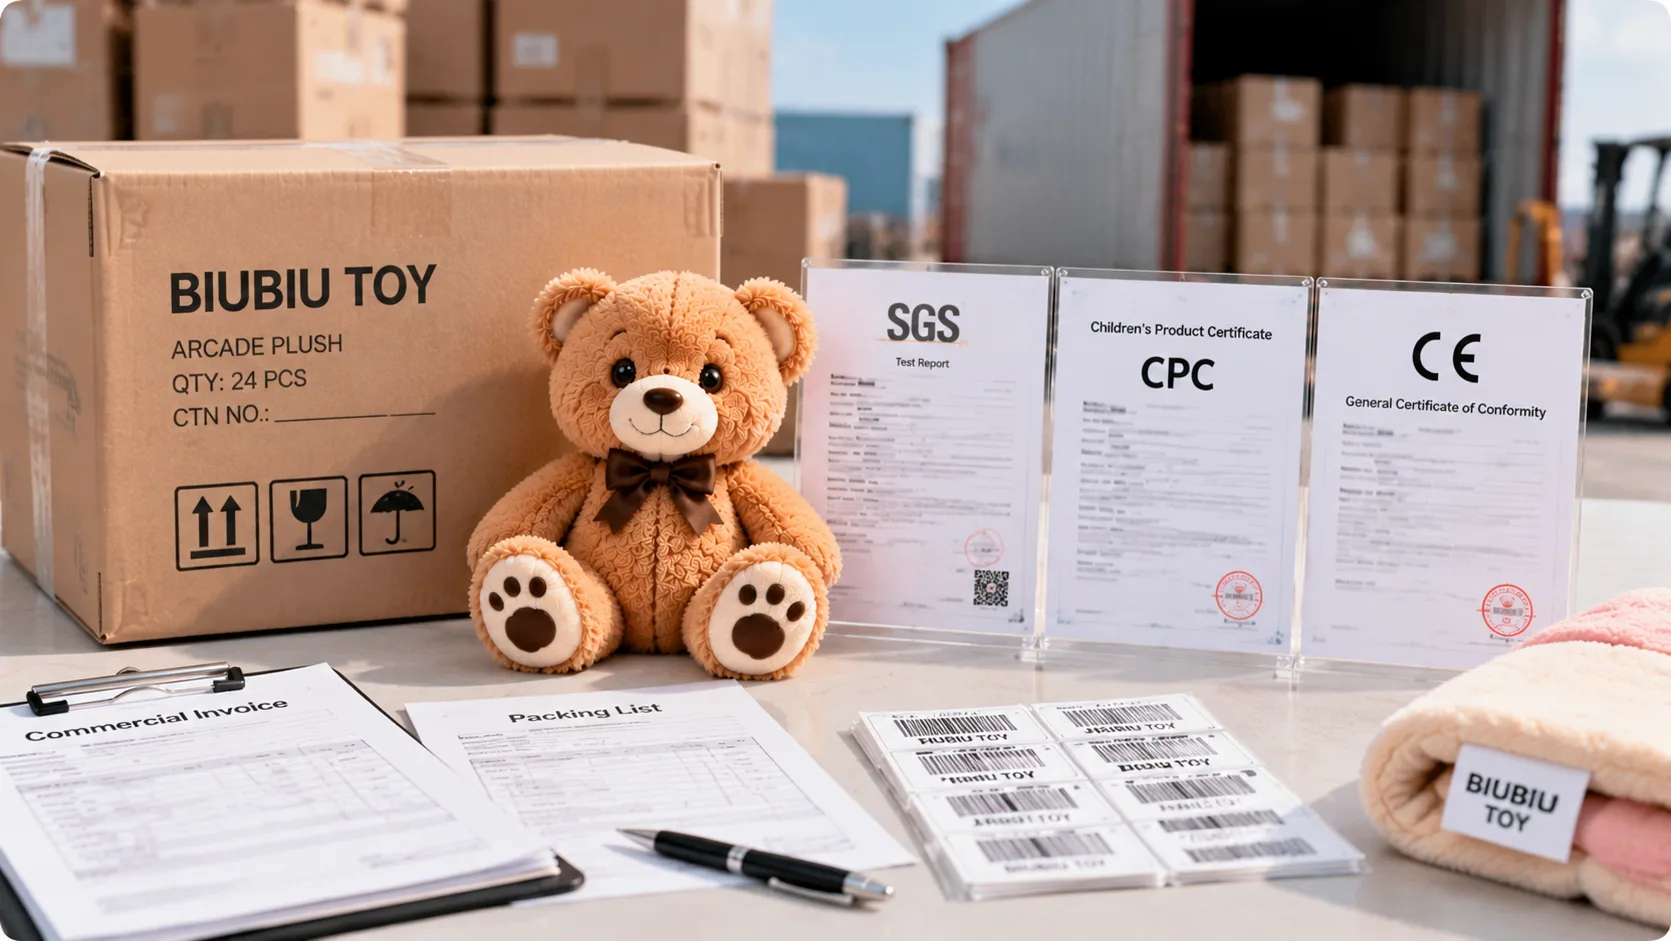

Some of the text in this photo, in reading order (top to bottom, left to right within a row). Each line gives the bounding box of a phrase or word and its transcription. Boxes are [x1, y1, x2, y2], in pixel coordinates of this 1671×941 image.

[170, 264, 437, 314] BIUBIU TOY
[887, 302, 960, 343] SGS
[1090, 320, 1273, 340] Children's Product Certificate
[171, 334, 343, 360] ARCADE PLUSH
[1412, 331, 1481, 383] CE
[896, 357, 950, 370] Test Report
[1141, 356, 1215, 391] CPC
[172, 368, 307, 395] QTY: 24 PCS
[173, 404, 269, 428] CTN NO.:
[1345, 395, 1547, 420] General Certificate of Conformity
[25, 711, 189, 742] Commercial
[193, 699, 288, 720] Invoice
[508, 703, 663, 723] Packing List
[1000, 770, 1035, 780] TOY
[1465, 772, 1559, 814] BIUBIU
[1484, 804, 1531, 832] TOY
